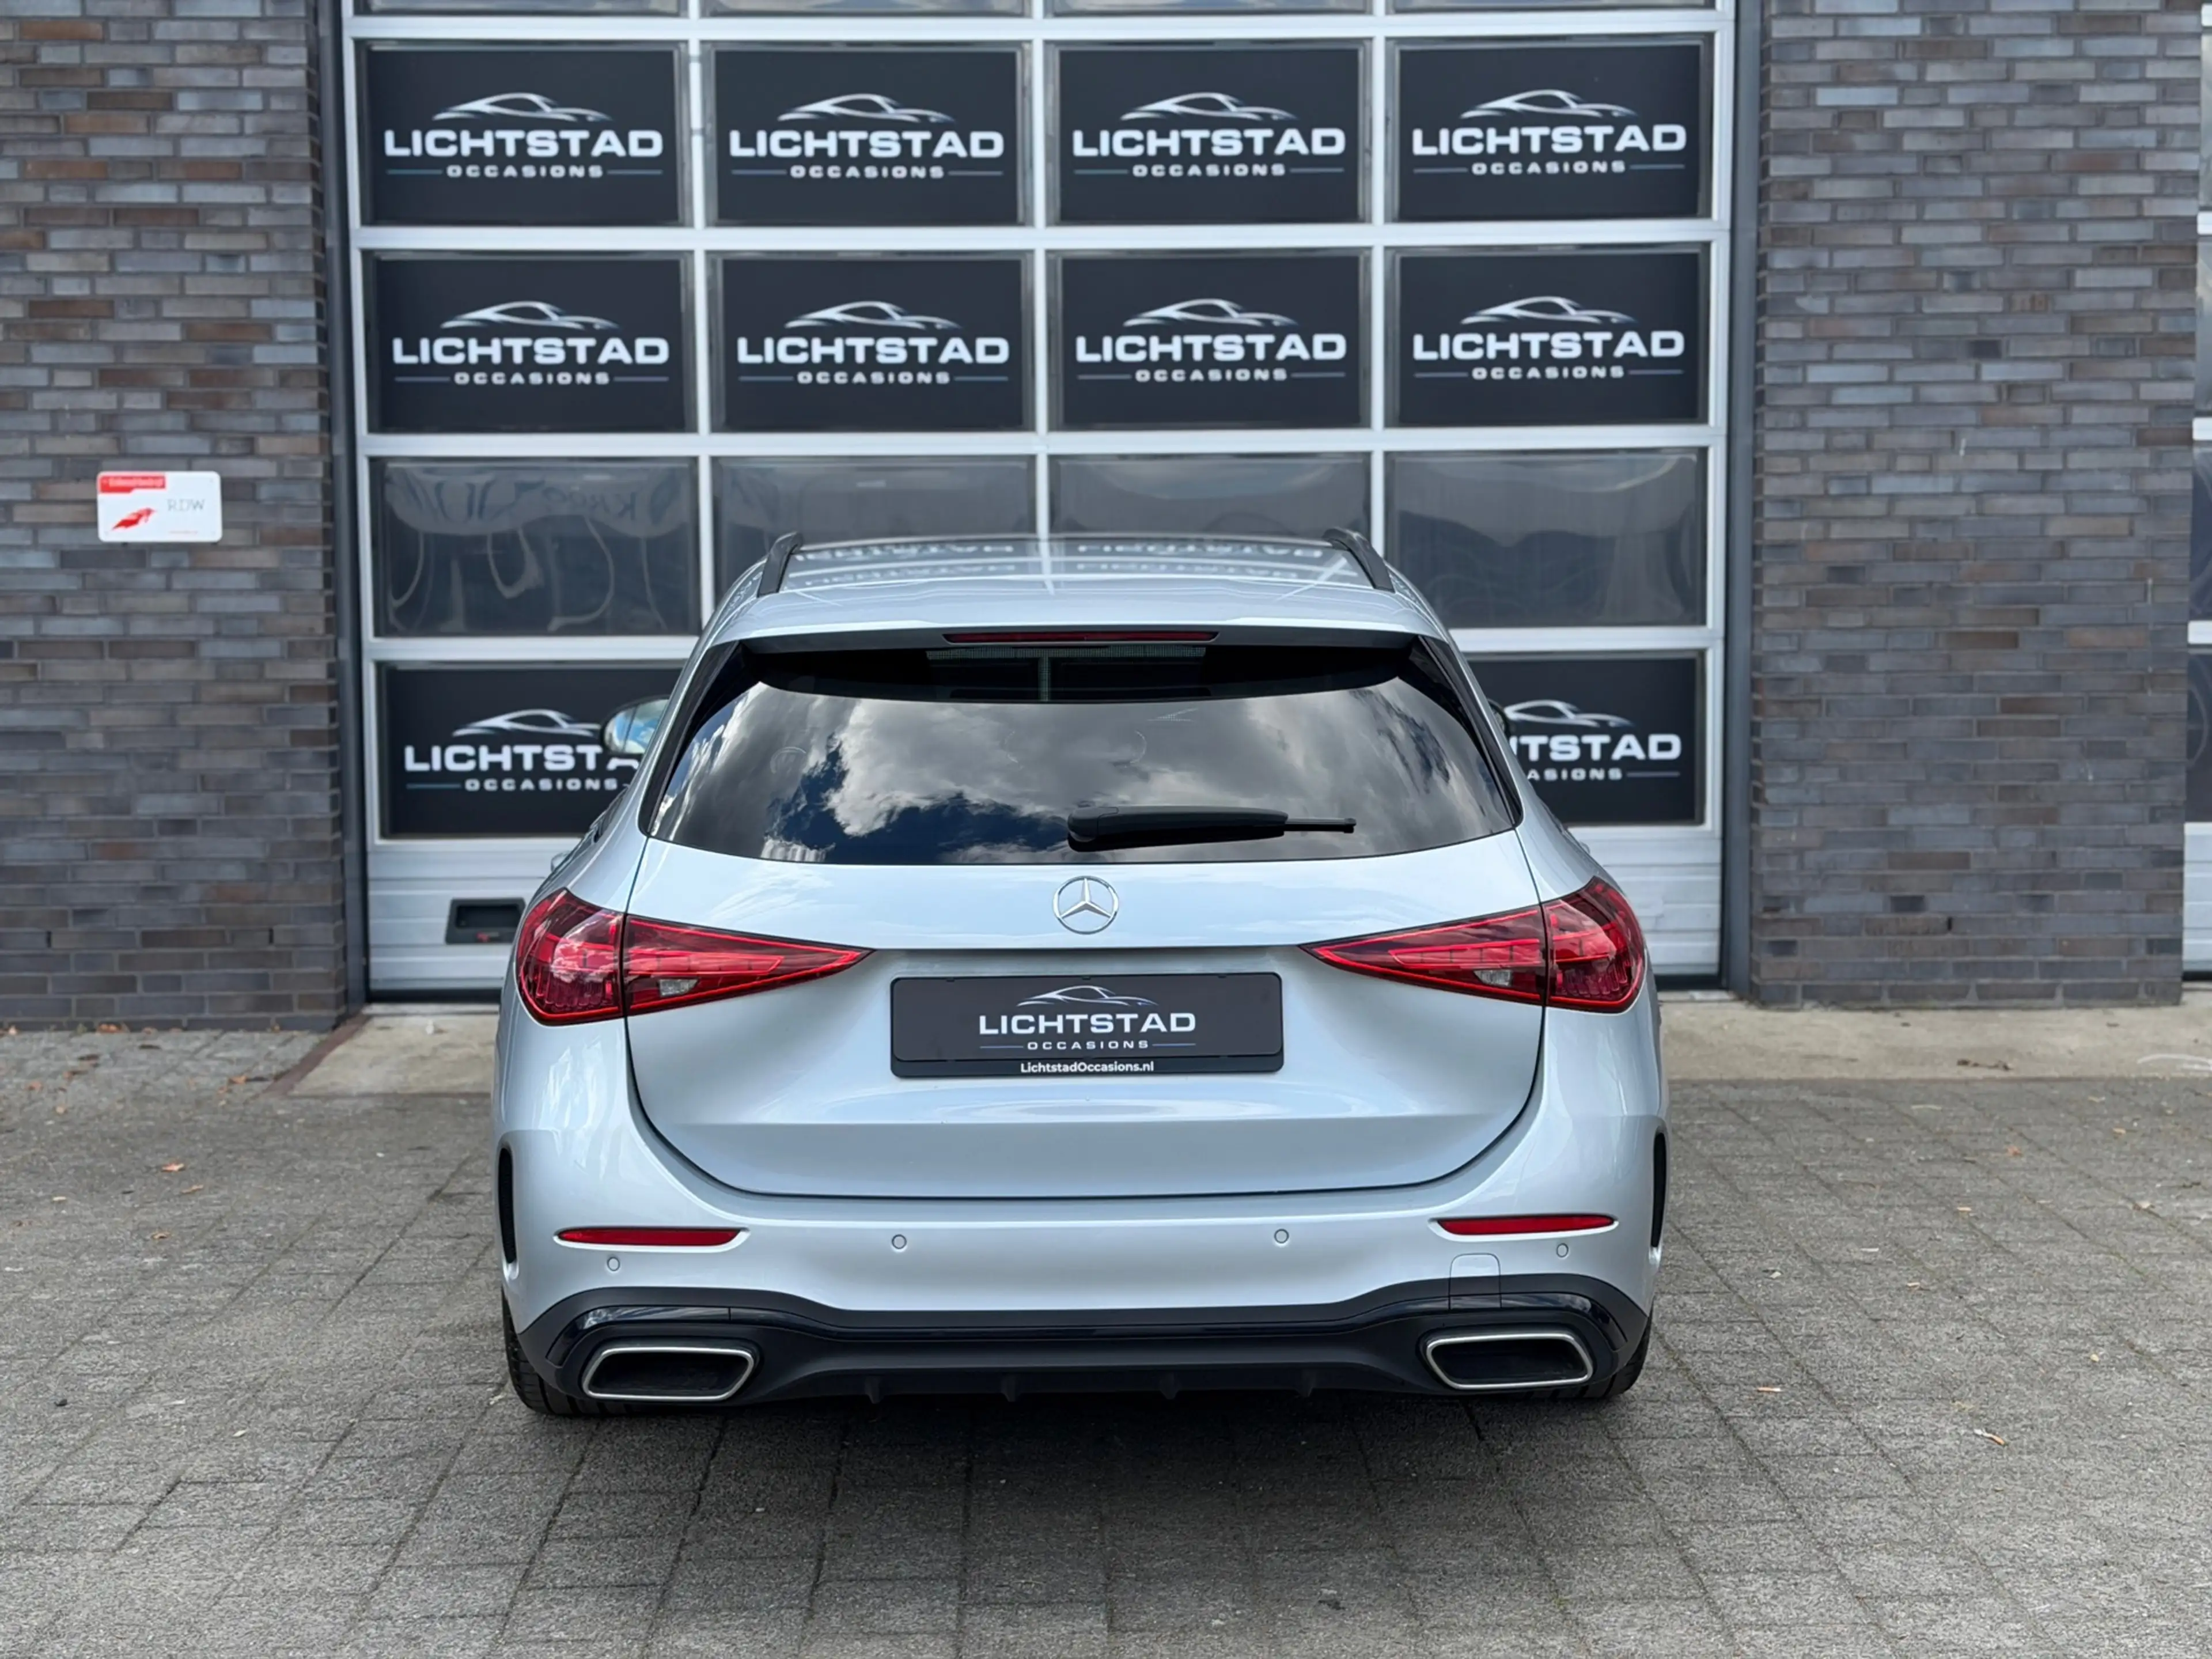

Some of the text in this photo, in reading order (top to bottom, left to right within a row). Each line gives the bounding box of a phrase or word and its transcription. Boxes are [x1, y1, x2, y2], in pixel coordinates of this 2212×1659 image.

[384, 128, 664, 158] LICHTSTAD
[729, 129, 1005, 159] LICHTSTAD
[1072, 127, 1346, 157] LICHTSTAD
[1411, 123, 1687, 156] LICHTSTAD
[446, 164, 604, 179] OCCASIONS
[789, 164, 945, 179] OCCASIONS
[1132, 162, 1286, 177] OCCASIONS
[1471, 160, 1626, 176] OCCASIONS
[392, 336, 670, 365] LICHTSTAD
[736, 336, 1010, 365] LICHTSTAD
[1075, 332, 1347, 363] LICHTSTAD
[1412, 329, 1685, 361] LICHTSTAD
[453, 371, 610, 385] OCCASIONS
[797, 370, 950, 385] OCCASIONS
[1134, 368, 1287, 383] OCCASIONS
[1471, 365, 1625, 381] OCCASIONS
[166, 498, 206, 512] RDW
[464, 778, 619, 791] OCCASIONS
[978, 1012, 1197, 1036] LICHTSTAD
[1027, 1039, 1150, 1051] OCCASIONS
[1020, 1060, 1155, 1074] LichtstadOccasions.nl
